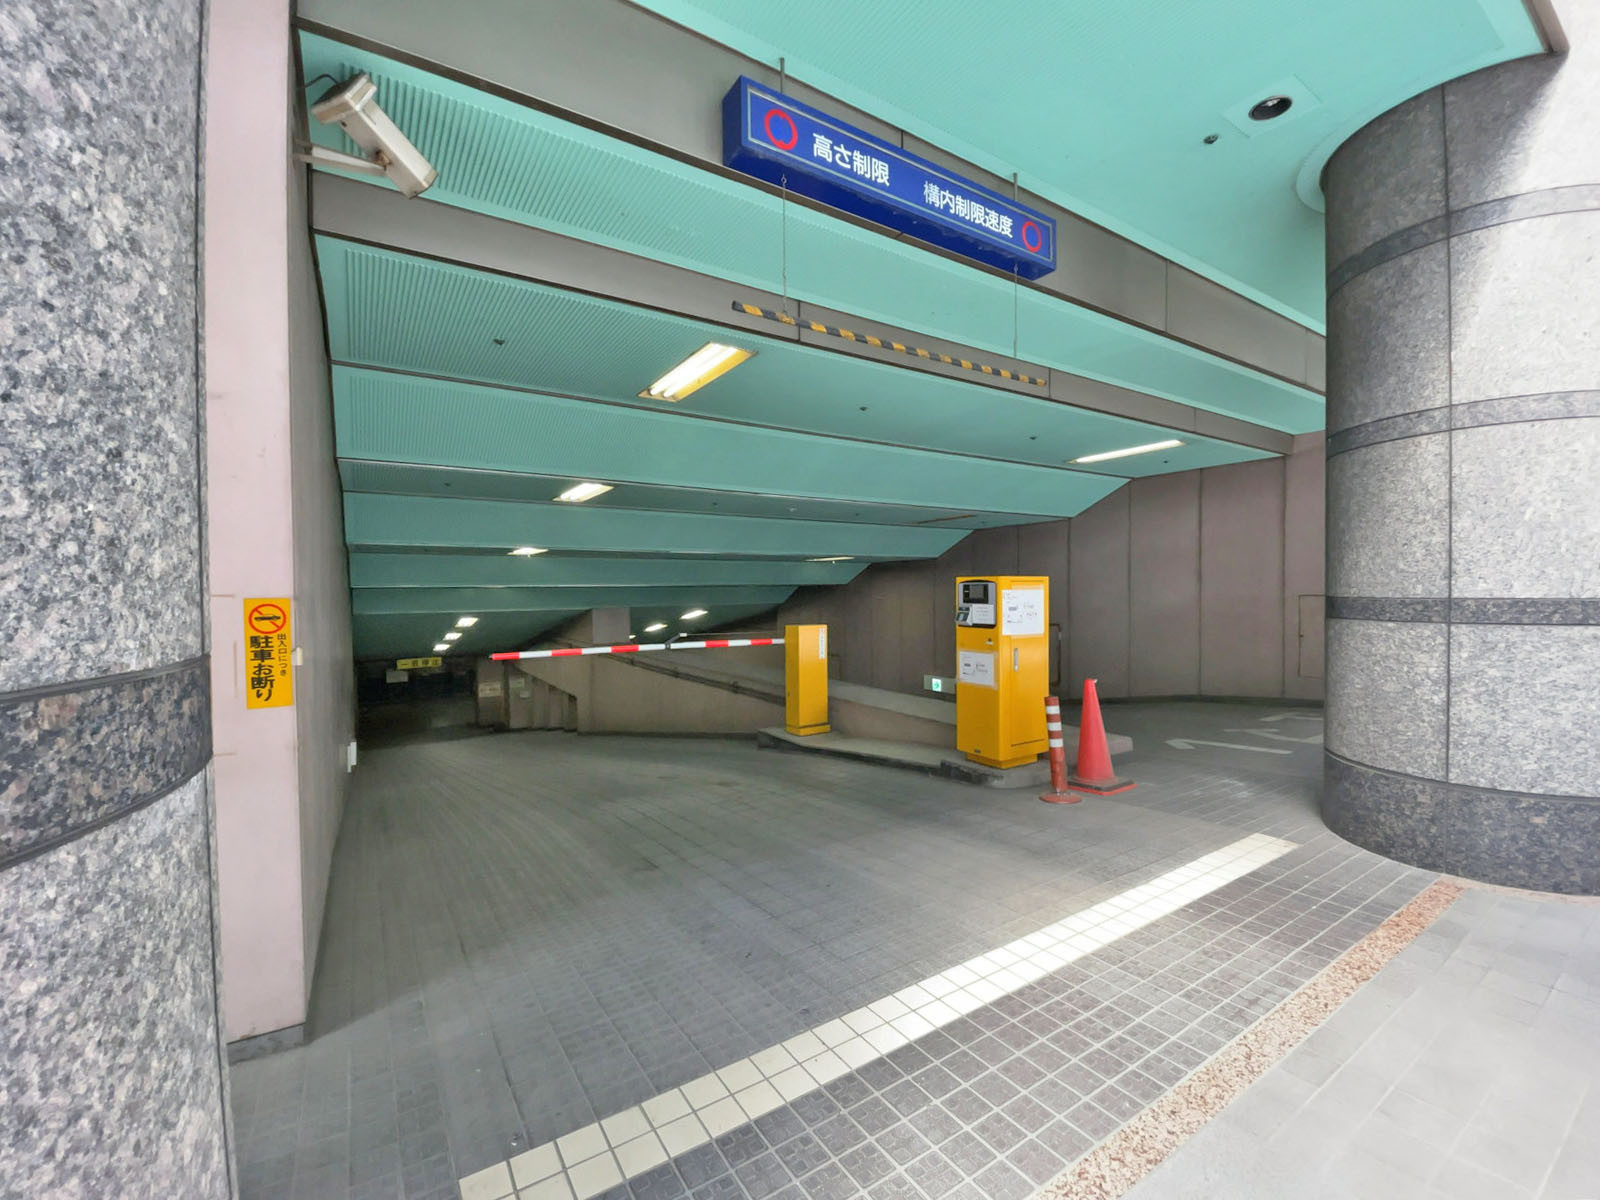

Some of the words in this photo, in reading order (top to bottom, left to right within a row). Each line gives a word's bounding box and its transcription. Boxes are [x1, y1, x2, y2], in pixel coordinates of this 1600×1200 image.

[812, 133, 890, 187] 高さ制限
[923, 181, 1014, 239] 構内制限速度
[249, 635, 275, 702] 駐車お断り
[277, 634, 288, 677] 出入口につき
